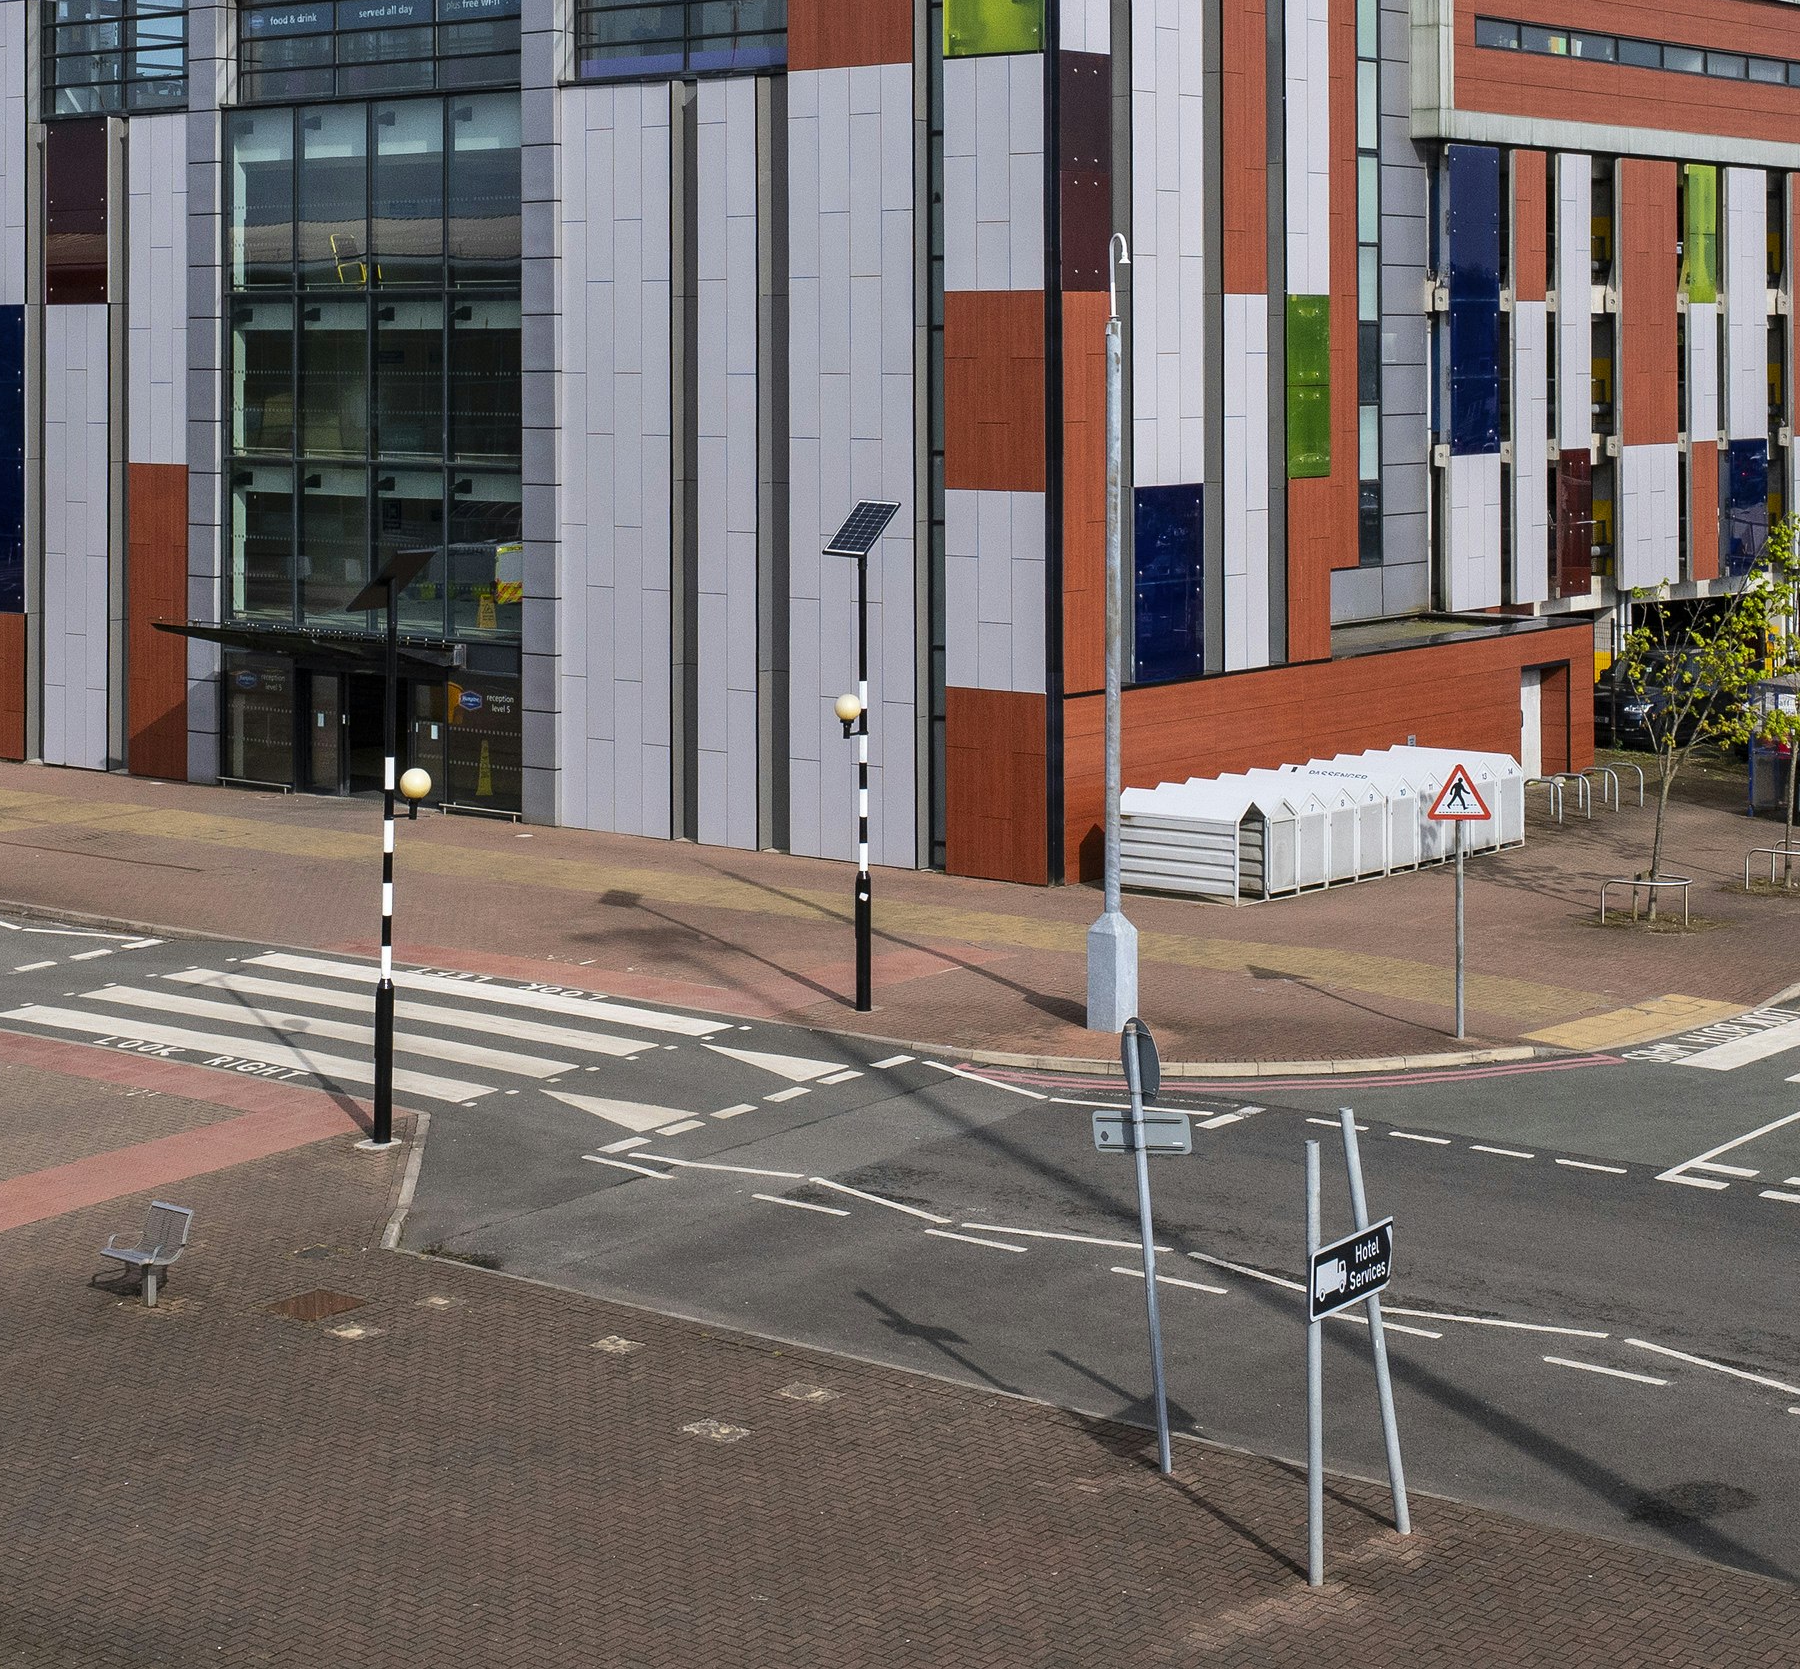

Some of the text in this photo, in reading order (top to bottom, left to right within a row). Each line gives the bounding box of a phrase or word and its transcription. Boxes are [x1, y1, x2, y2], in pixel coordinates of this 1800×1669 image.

[446, 0, 461, 12] plus
[359, 4, 413, 19] served all day
[270, 15, 288, 26] food
[289, 16, 296, 24] &
[298, 13, 317, 24] drink
[486, 695, 515, 703] reception
[491, 704, 511, 713] level 5
[1400, 787, 1407, 797] 10
[1340, 798, 1345, 807] 8
[1369, 793, 1374, 802] 9
[1310, 803, 1315, 812] 7
[1355, 1236, 1380, 1263] Hotel
[1349, 1261, 1386, 1290] Services
